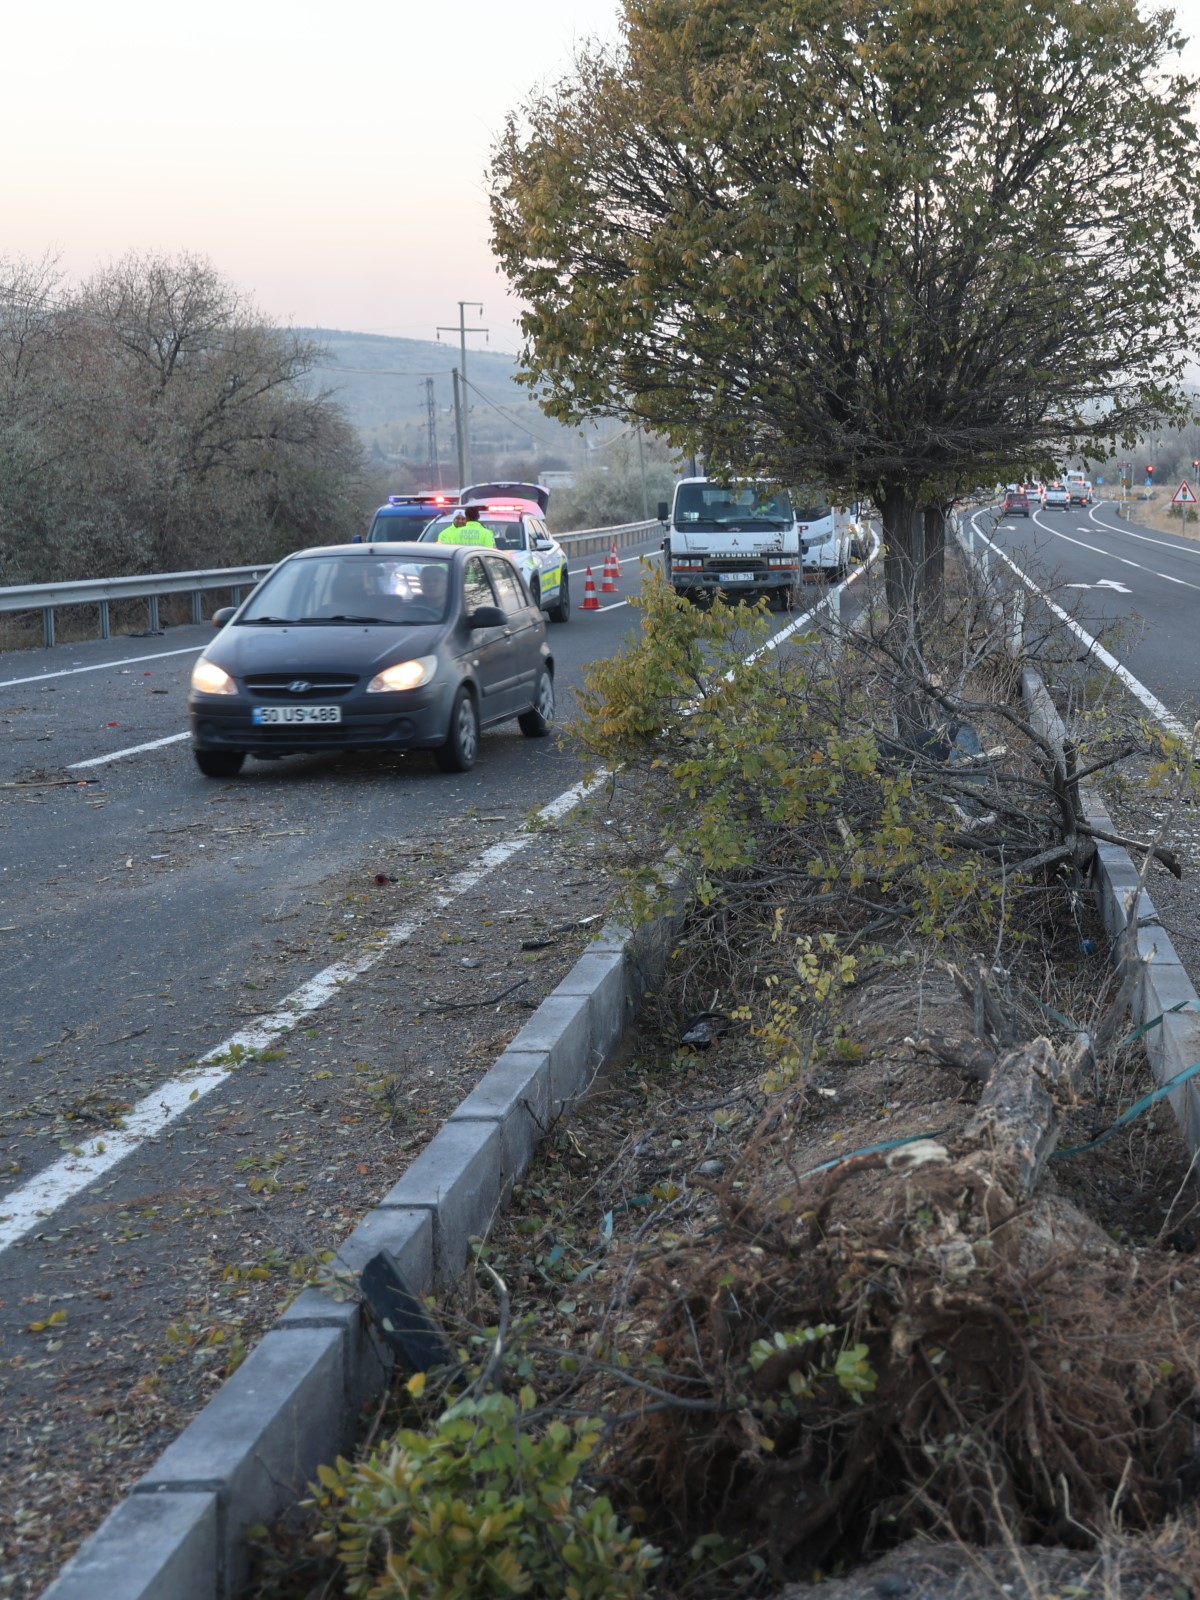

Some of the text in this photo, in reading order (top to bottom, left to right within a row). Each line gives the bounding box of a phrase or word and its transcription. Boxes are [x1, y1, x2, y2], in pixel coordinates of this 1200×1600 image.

[261, 708, 337, 722] 50 US 486
